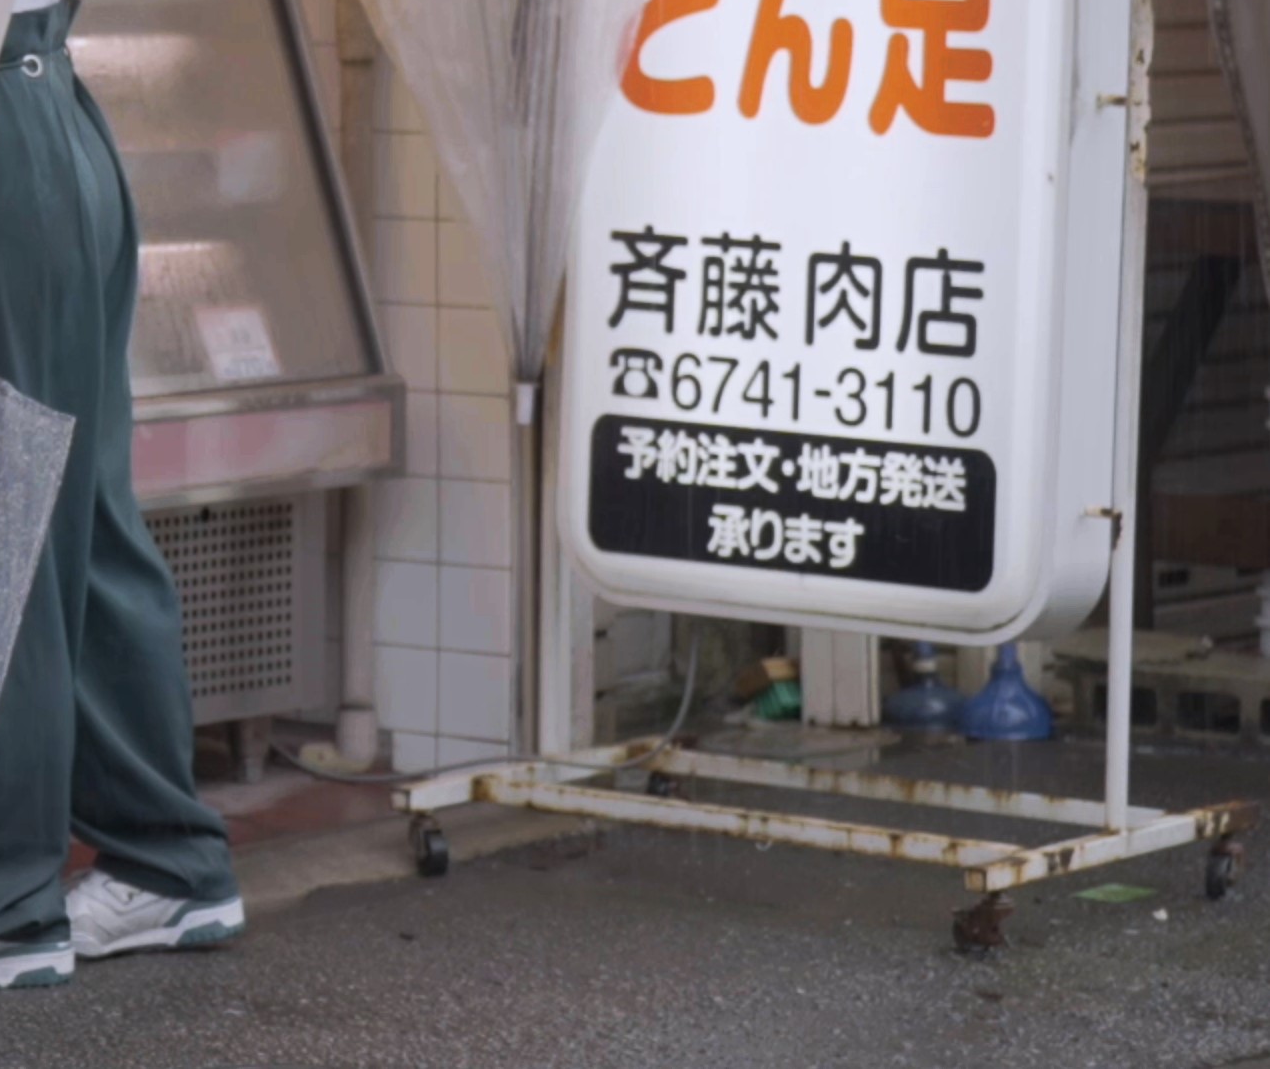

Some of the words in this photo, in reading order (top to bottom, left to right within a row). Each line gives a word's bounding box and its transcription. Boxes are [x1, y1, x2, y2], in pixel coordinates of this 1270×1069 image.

[607, 225, 986, 358] 斉藤肉店
[670, 352, 981, 438] 6741-3110
[617, 426, 966, 512] 予約注文・地方発送
[707, 506, 864, 568] 承ります
